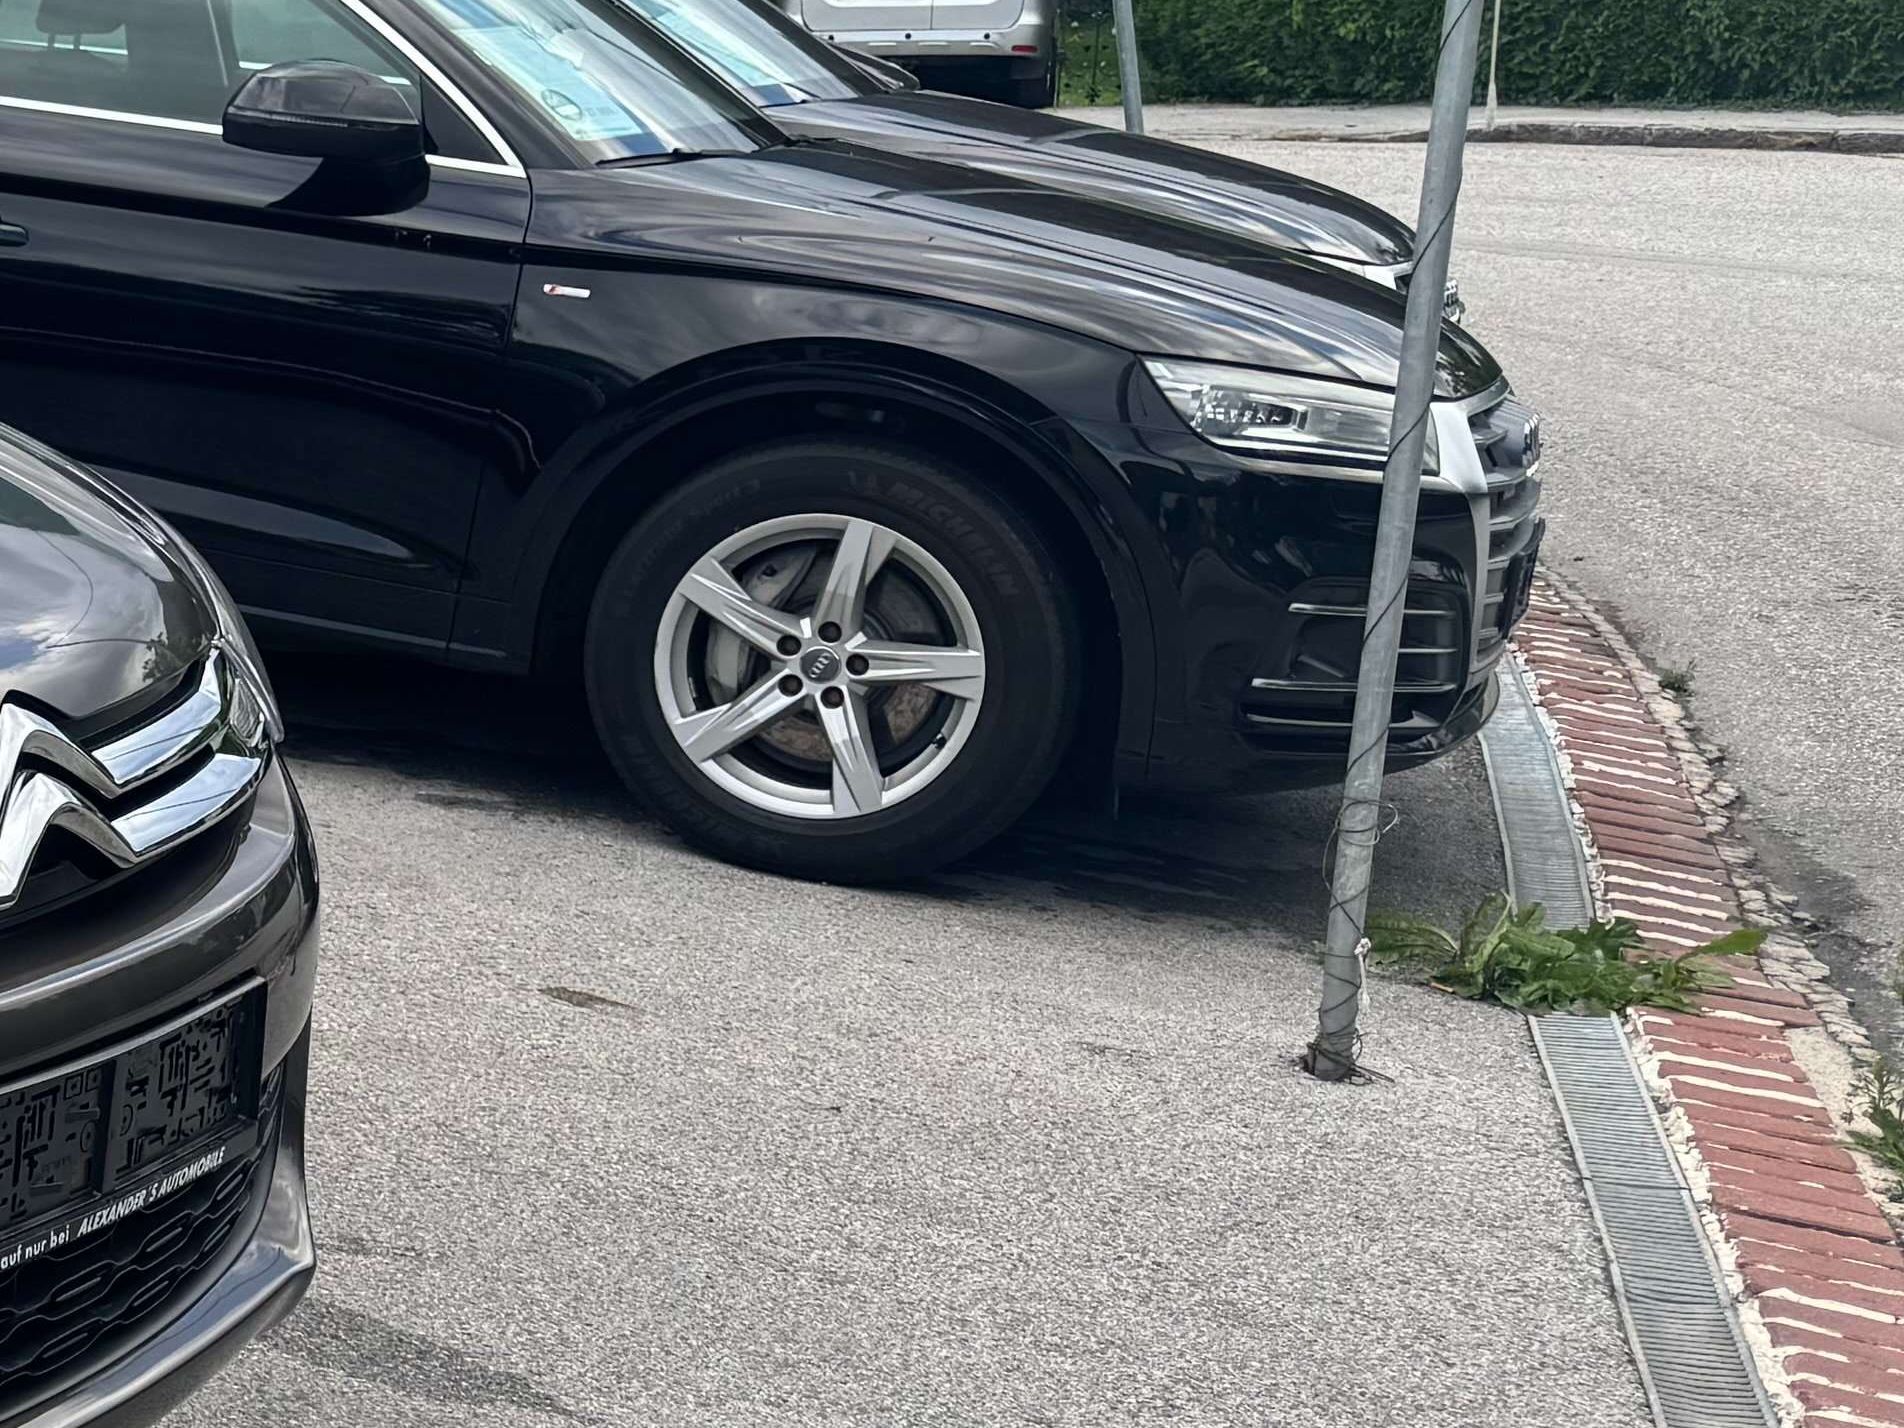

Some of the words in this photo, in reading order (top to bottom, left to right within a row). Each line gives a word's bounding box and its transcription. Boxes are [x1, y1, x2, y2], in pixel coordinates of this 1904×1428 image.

[24, 1238, 48, 1260] nur
[49, 1223, 70, 1250] bei
[157, 1145, 226, 1198] AUTOMOBILE
